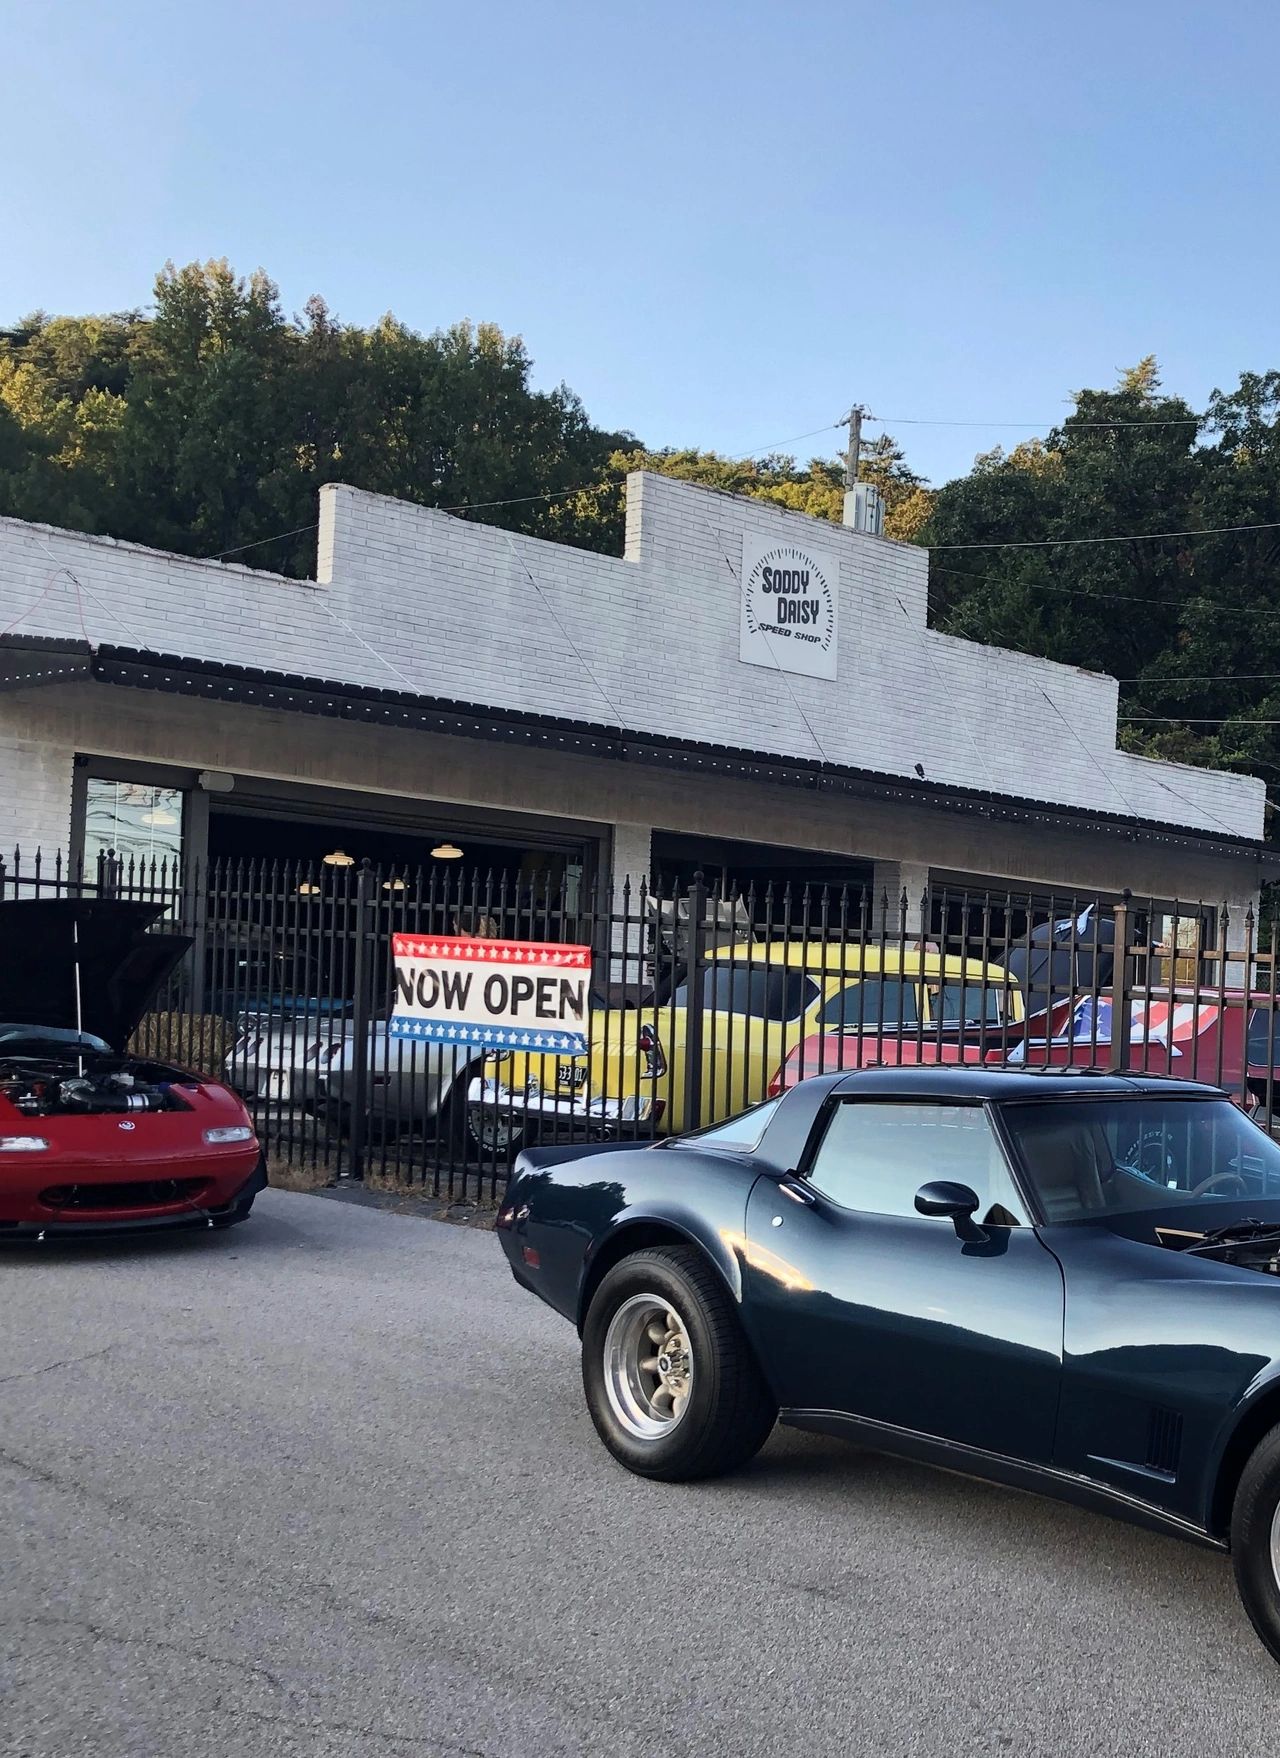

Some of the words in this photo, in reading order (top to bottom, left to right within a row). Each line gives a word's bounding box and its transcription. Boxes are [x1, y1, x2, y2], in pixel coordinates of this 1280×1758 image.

[762, 566, 810, 594] SODDY
[777, 597, 819, 624] DAISY
[758, 622, 792, 637] SPEED
[794, 631, 821, 644] SHOP
[395, 967, 473, 1011] NOW
[484, 973, 585, 1021] OPEN
